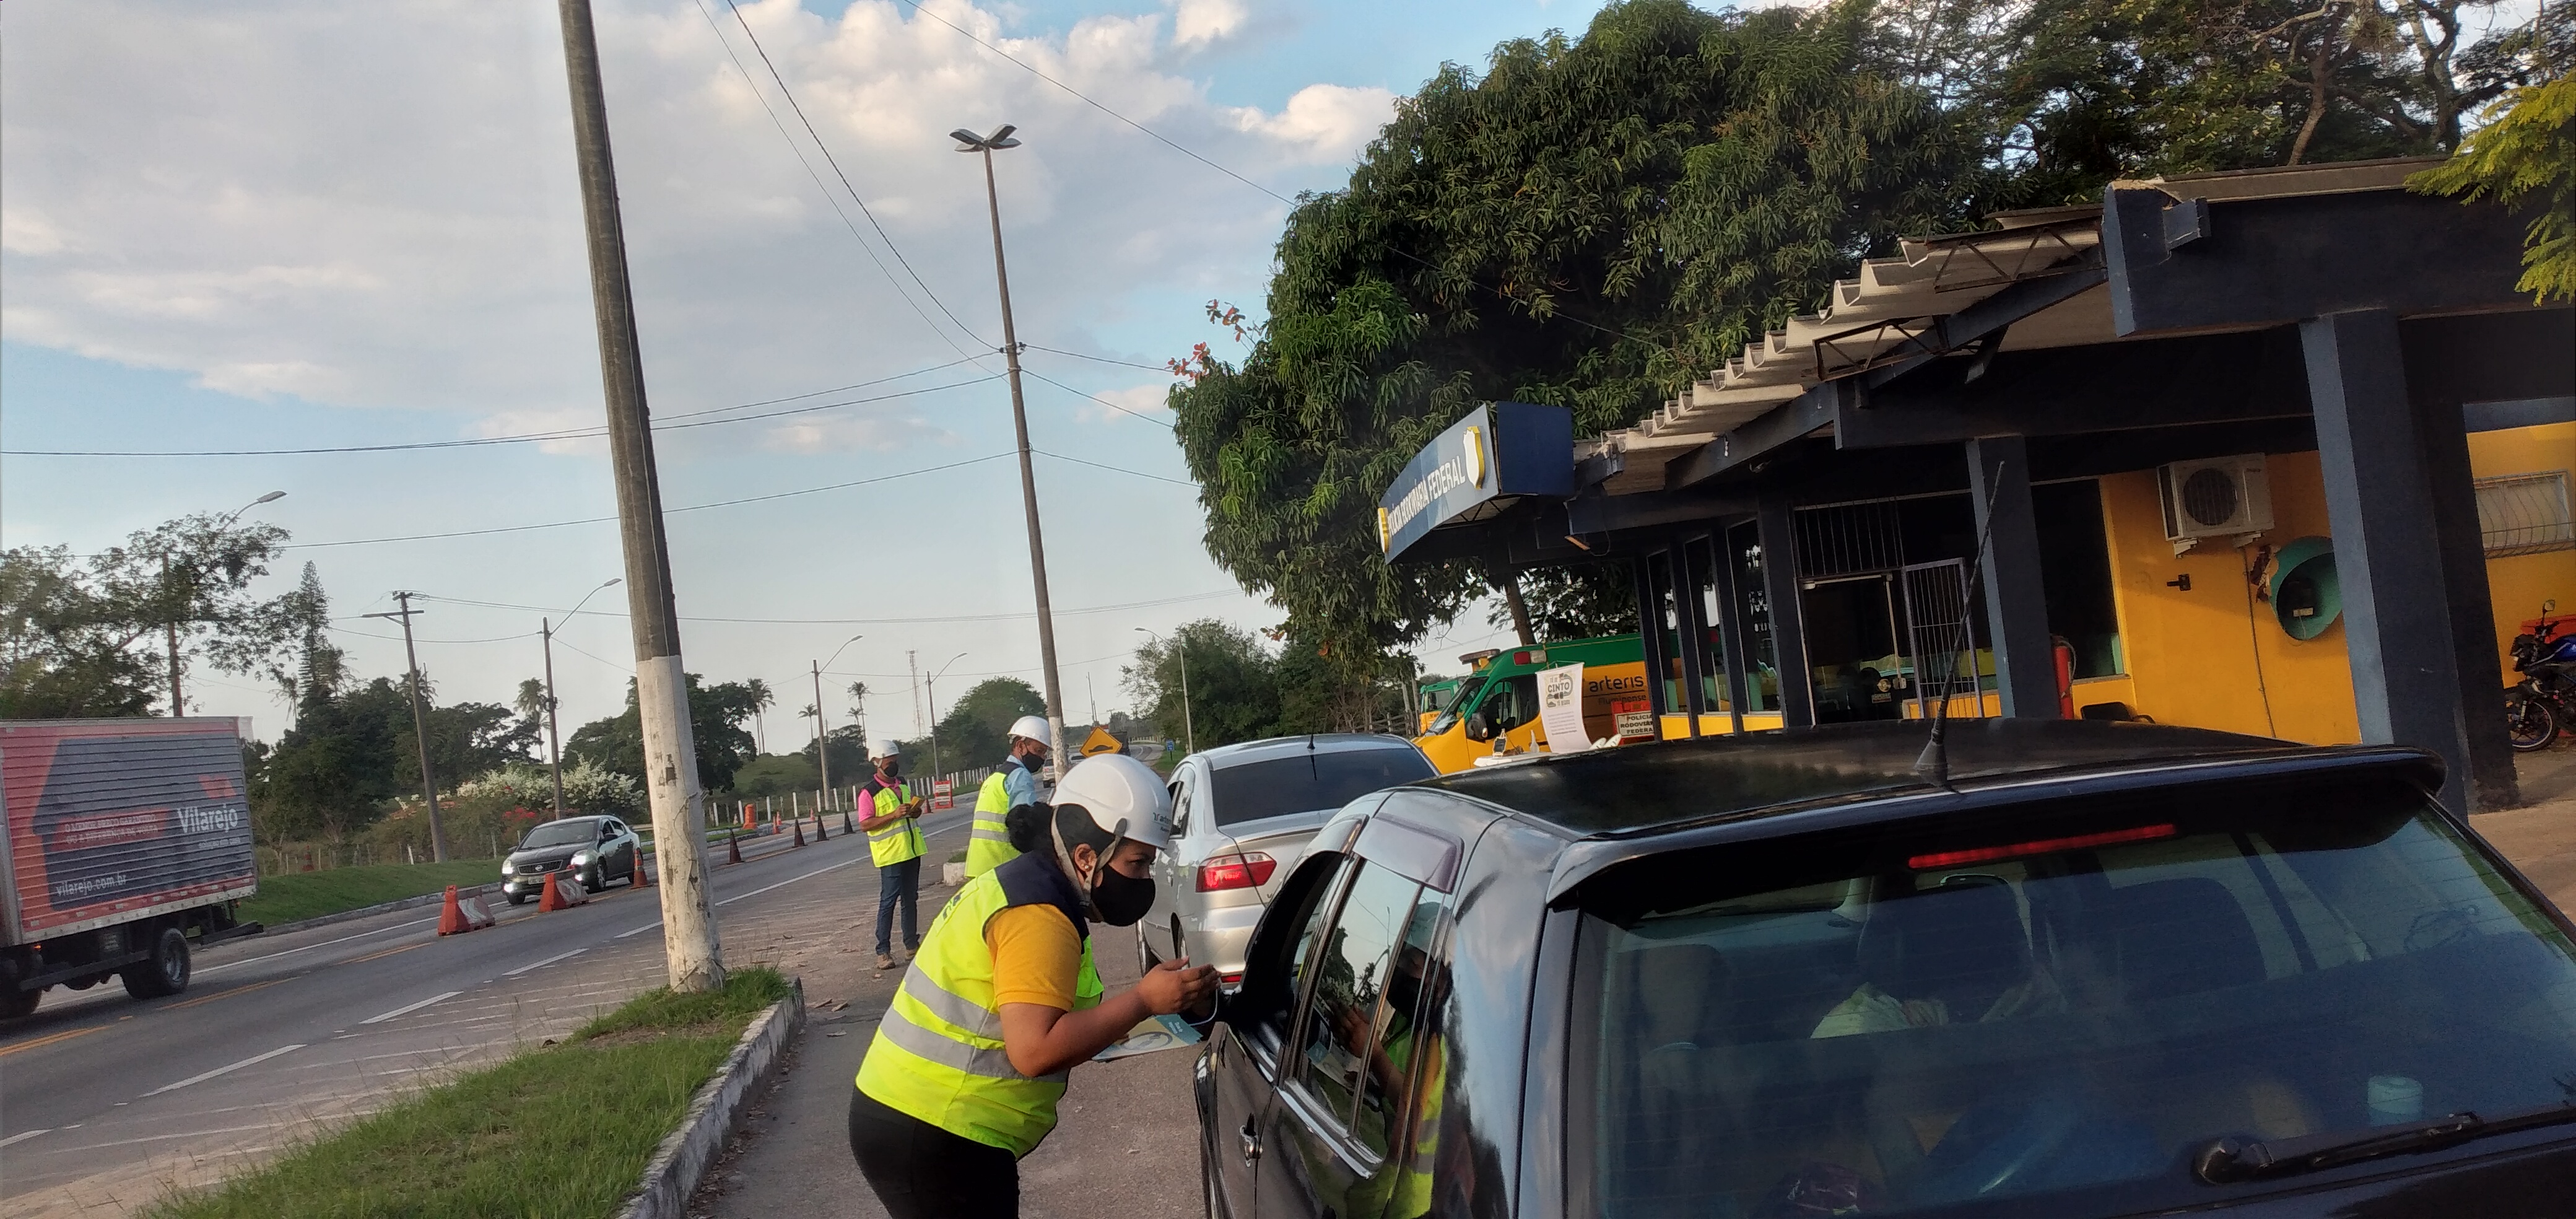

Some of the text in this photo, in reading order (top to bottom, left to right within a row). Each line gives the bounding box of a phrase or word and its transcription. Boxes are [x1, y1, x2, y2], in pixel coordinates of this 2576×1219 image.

[1427, 455, 1466, 502] FEDERAL
[1548, 681, 1570, 693] CINTO
[1588, 675, 1645, 693] arteris
[176, 803, 238, 833] Vilarejo
[56, 871, 127, 896] vilarejo.com.br
